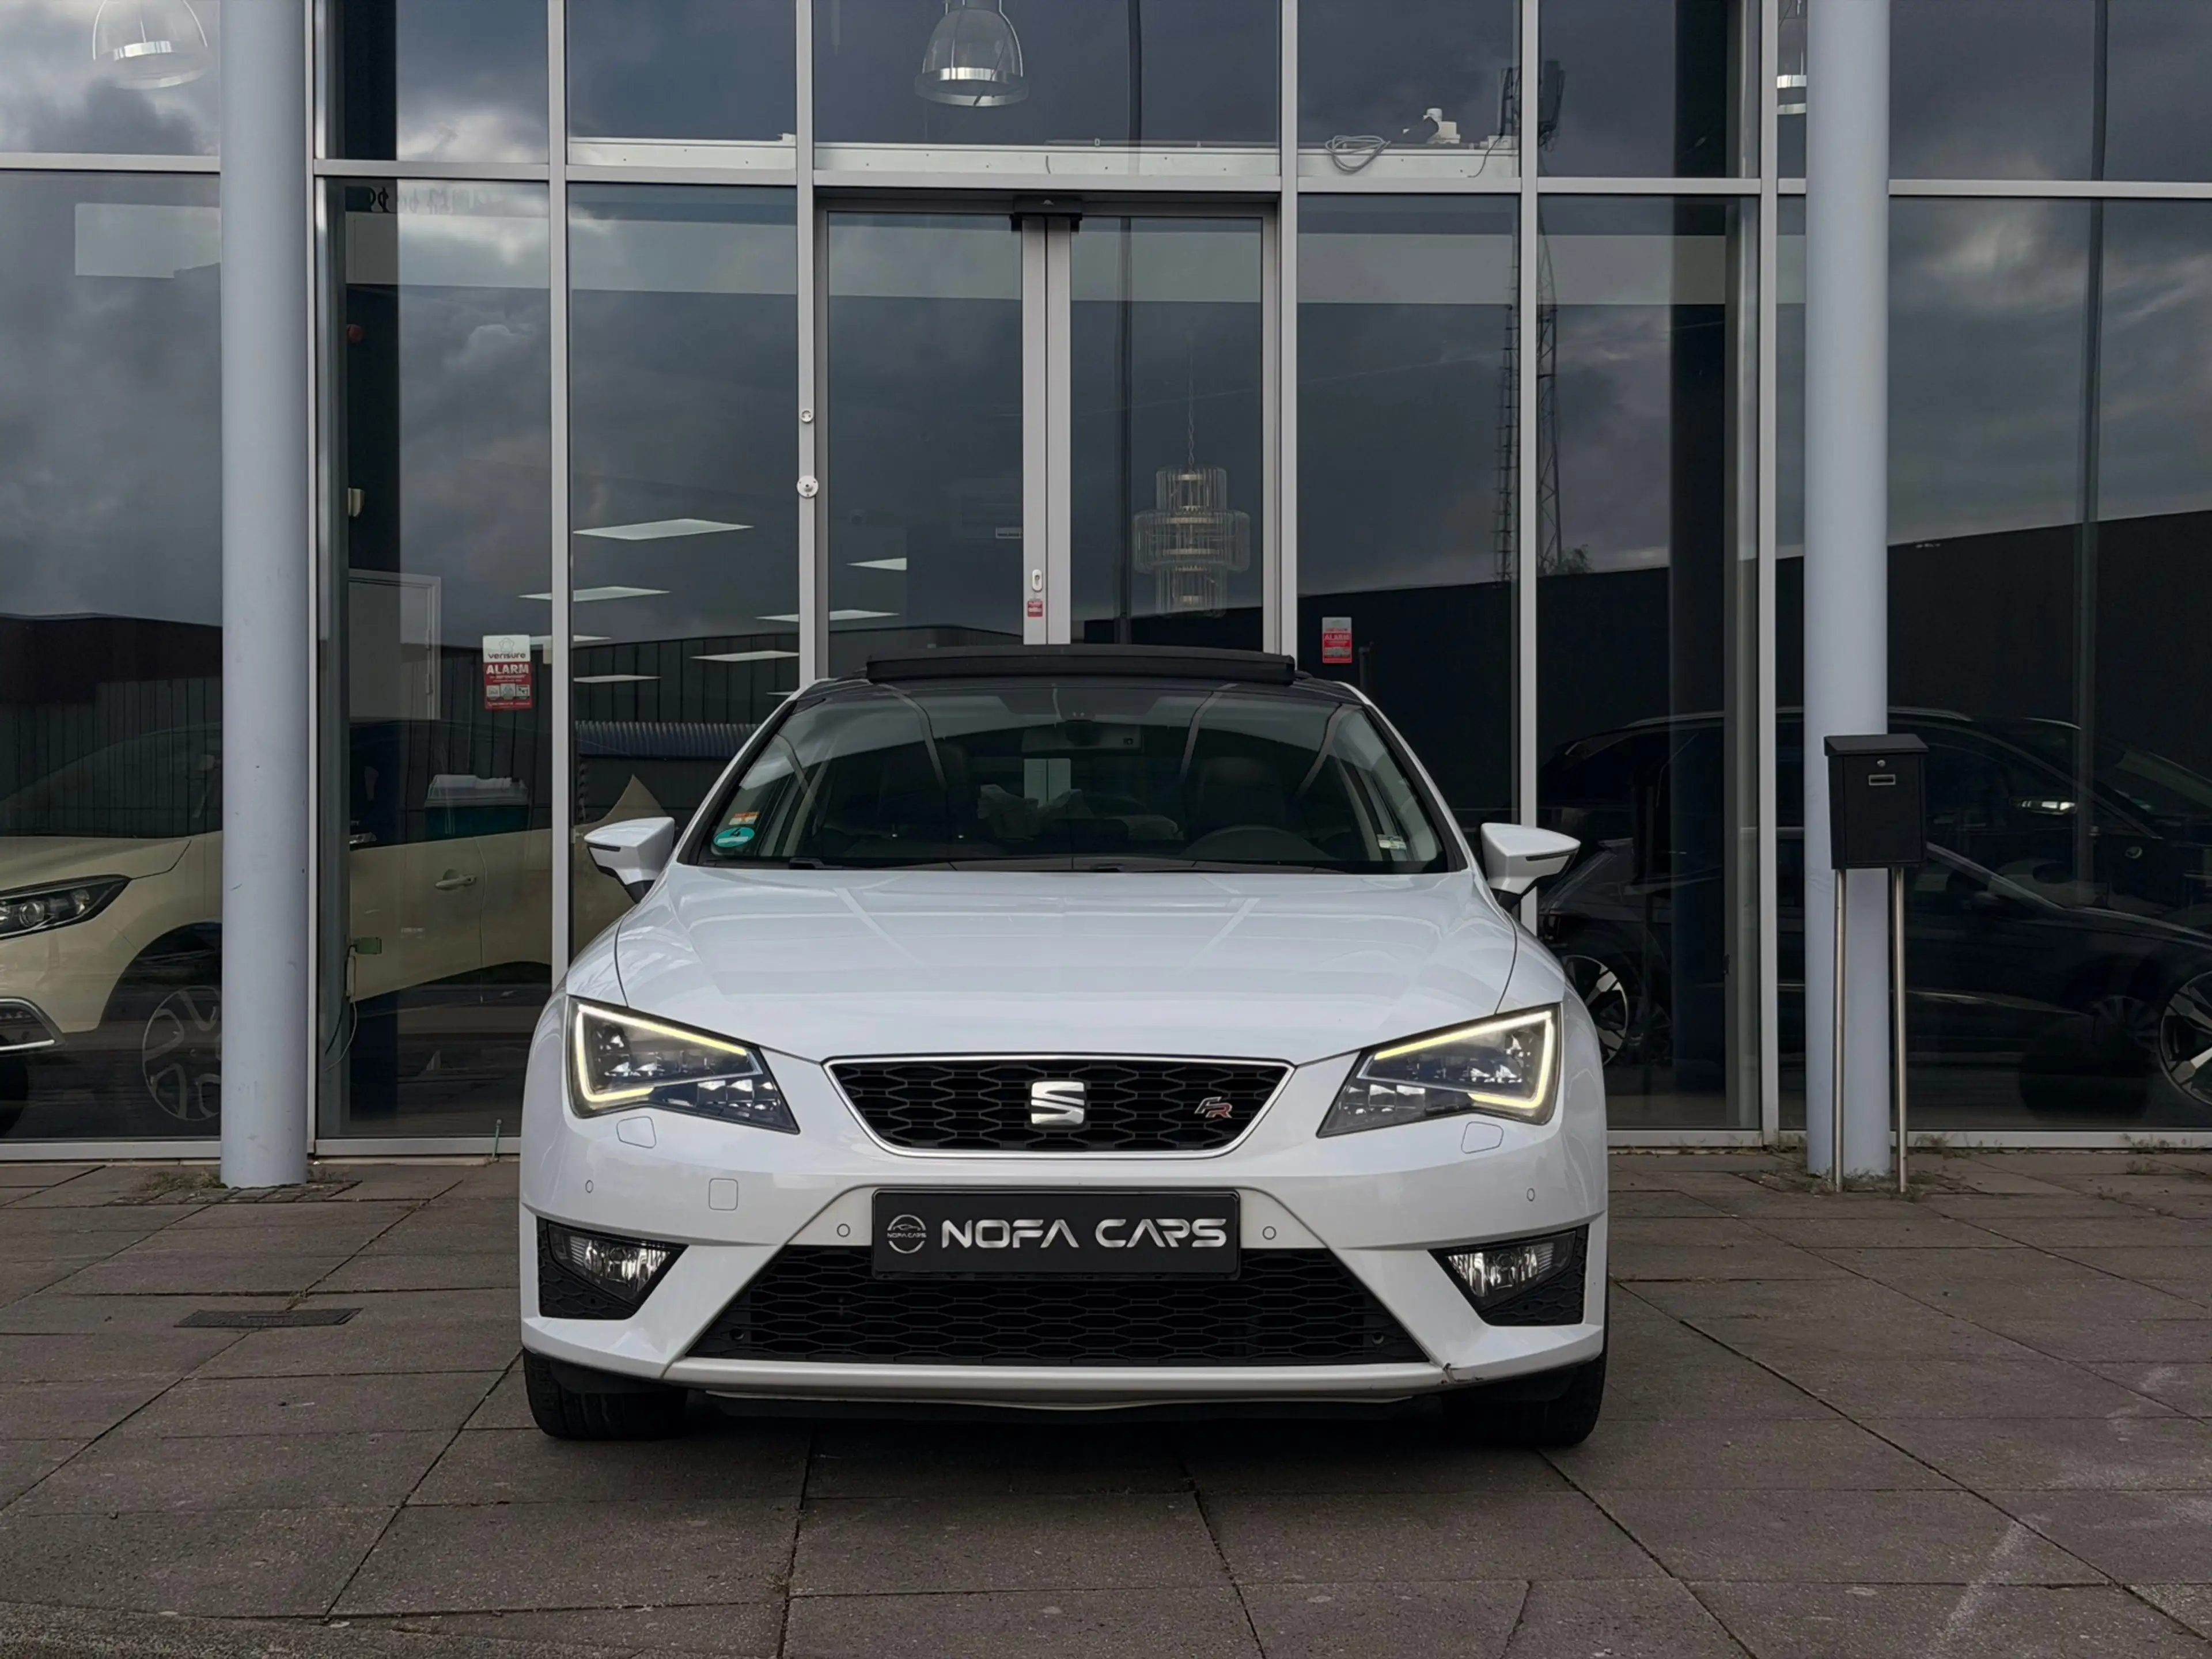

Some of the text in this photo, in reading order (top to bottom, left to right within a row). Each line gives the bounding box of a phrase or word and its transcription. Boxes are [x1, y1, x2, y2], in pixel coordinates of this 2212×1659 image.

[487, 664, 528, 674] ALARM
[1194, 1096, 1233, 1119] FR
[941, 1218, 1227, 1249] NOFA CARS
